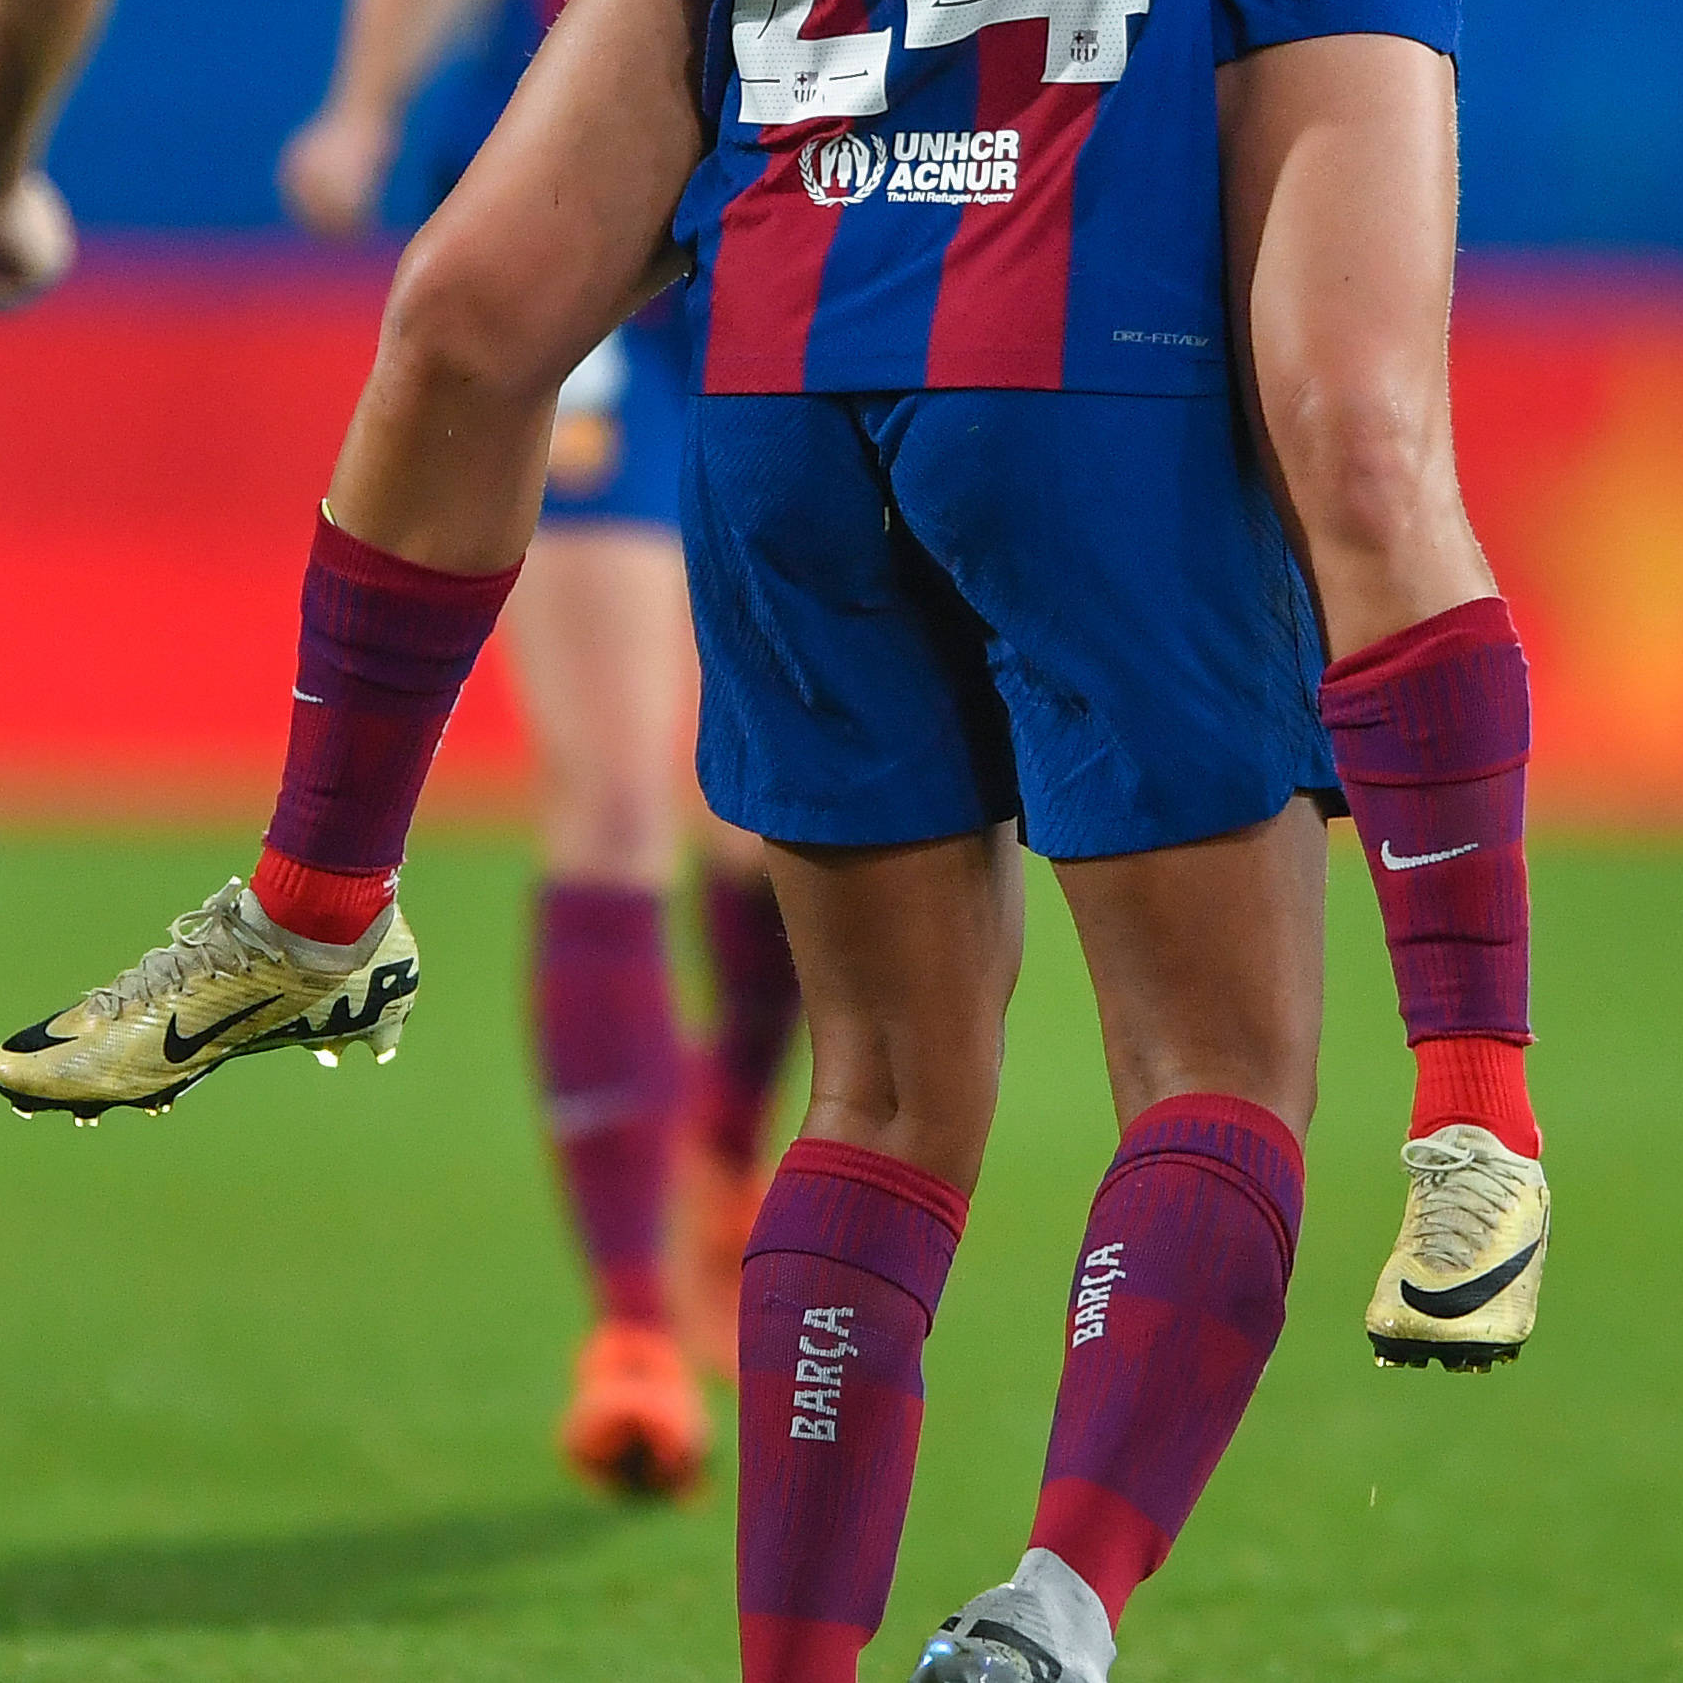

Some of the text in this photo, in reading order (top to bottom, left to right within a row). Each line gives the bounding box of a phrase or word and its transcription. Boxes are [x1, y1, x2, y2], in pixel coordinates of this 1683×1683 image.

[894, 130, 1020, 161] UNHCR
[887, 161, 1017, 191] ACNUR
[887, 192, 1014, 206] The UN Refugee Agency
[1073, 1242, 1127, 1349] BARÇA
[790, 1306, 859, 1442] BARÇA
